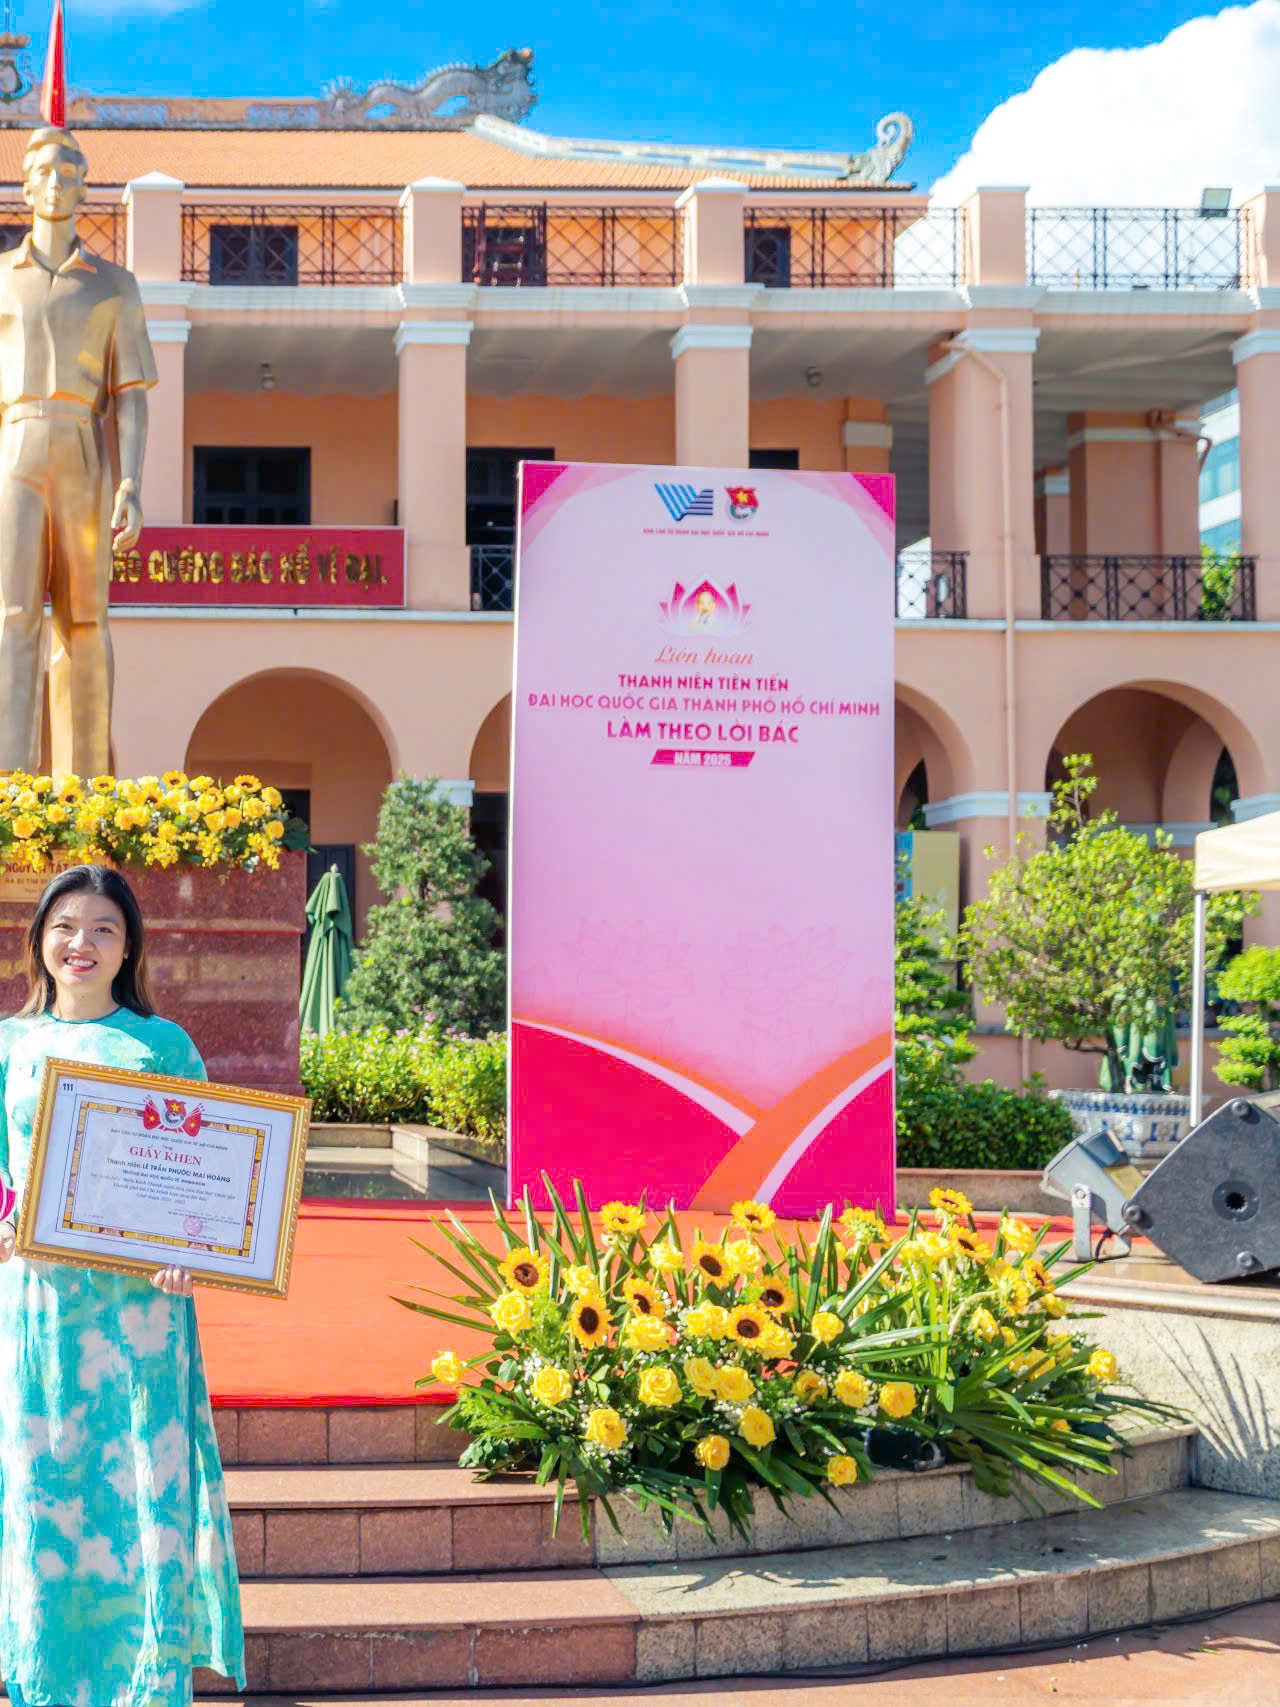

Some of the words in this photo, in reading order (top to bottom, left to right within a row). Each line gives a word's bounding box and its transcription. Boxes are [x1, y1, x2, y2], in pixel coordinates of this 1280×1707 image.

[109, 551, 141, 583] EO
[704, 648, 753, 664] hoan
[618, 674, 672, 688] THANH
[677, 672, 713, 689] NIÊN
[718, 673, 751, 691] TIÊN
[528, 693, 555, 709] ĐẠI
[561, 694, 594, 711] HỌC
[649, 697, 678, 711] GIA
[683, 695, 737, 712] THÀNH
[781, 694, 805, 714] HỒ
[810, 698, 834, 715] CHÍ
[839, 702, 880, 716] MINH
[607, 716, 651, 739] LÀM
[657, 722, 712, 741] THEO
[718, 719, 752, 742] LỜI
[759, 720, 799, 743] BÁC
[63, 1083, 73, 1091] 111
[130, 1144, 162, 1159] GIẤY
[164, 1151, 202, 1166] KHEN
